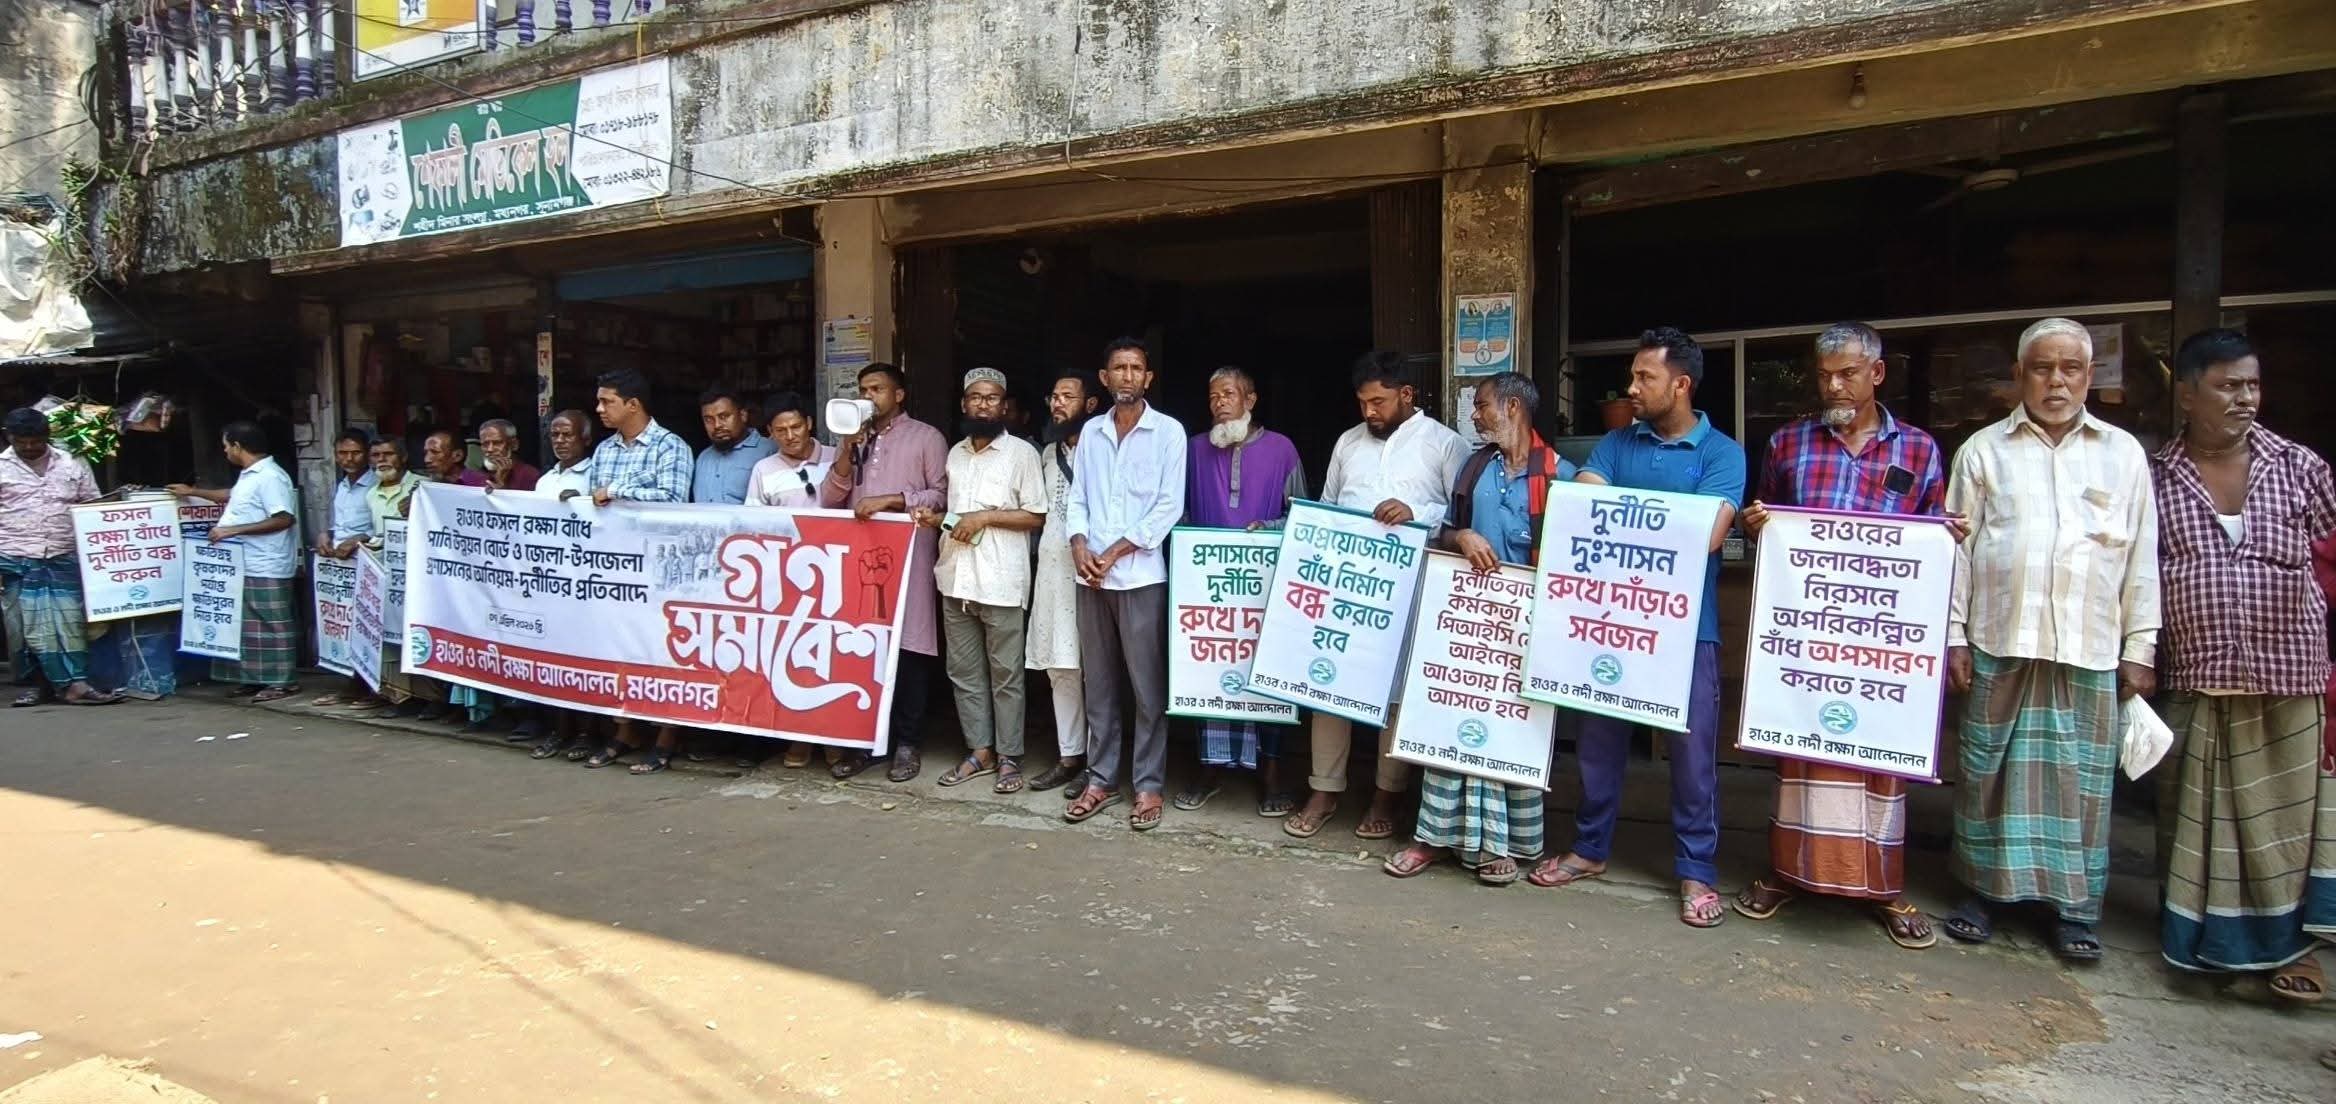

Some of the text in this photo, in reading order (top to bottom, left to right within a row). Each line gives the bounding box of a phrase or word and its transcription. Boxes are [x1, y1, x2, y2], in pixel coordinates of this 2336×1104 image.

[101, 508, 152, 523] ফসল
[486, 511, 520, 532] ফসল
[524, 515, 558, 536] রক্ষা
[561, 512, 592, 539] বাঁধে
[1590, 494, 1670, 535] দুর্নীতি
[1810, 518, 1904, 547] হাওরের
[85, 529, 130, 547] রক্ষা
[133, 523, 172, 540] বাঁধে
[428, 526, 451, 550] পানি
[452, 531, 481, 557] উন্নয়ন
[484, 534, 510, 559] বোর্ড
[513, 547, 522, 561] ও
[525, 542, 644, 573] জেলা-উপজেলা
[1294, 522, 1416, 570] অপ্রয়োজনীয়
[86, 544, 176, 571] দুর্নীতি বন্ধ
[1192, 544, 1281, 567] প্রশাসনের
[1571, 535, 1678, 576] দুঃশাসন
[1789, 547, 1922, 580] জলাবদ্ধতা
[109, 566, 162, 583] করুন
[427, 557, 472, 581] প্রশাসনের
[472, 561, 572, 598] অনিয়ম-দুর্নীতির
[575, 573, 648, 603] প্রতিবাদে
[722, 538, 850, 618] গণ
[1206, 567, 1263, 603] দুর্নীতি
[1297, 553, 1395, 601] বাঁধ নির্মাণ
[1804, 573, 1899, 609] নিরসনে
[1286, 581, 1393, 631] বন্ধ করতে
[1448, 592, 1521, 623] কর্মকর্তা
[1547, 572, 1689, 620] রুখে দাঁড়াও
[213, 612, 232, 625] হবে
[1178, 604, 1237, 633] রুখে
[1436, 610, 1515, 645] পিআইসি
[1568, 611, 1659, 655] সর্বজন
[1772, 605, 1928, 646] অপরিকল্পিত
[669, 594, 894, 711] সমাবেশ
[1189, 636, 1259, 664] জনগ
[1312, 625, 1350, 653] হবে
[1449, 641, 1523, 671] আইনের
[1760, 629, 1936, 677] বাঁধ অপসারণ
[435, 637, 720, 709] হাওর ও নদী রক্ষা আন্দোলন, মধ্যনগর
[1423, 662, 1524, 697] আওতায় নি
[1780, 667, 1907, 704] করতে হবে
[1175, 696, 1197, 707] হাওর
[1199, 697, 1206, 708] ও
[1207, 696, 1224, 710] নদী
[1247, 702, 1293, 716] আন্দোলন
[1254, 673, 1279, 689] হাওর
[1280, 680, 1288, 690] ও
[1290, 681, 1308, 695] নদী
[1333, 694, 1381, 717] আন্দোলন
[1428, 686, 1530, 721] আসতে হবে
[1530, 676, 1680, 719] হাওর ও নদী রক্ষা আন্দোলন
[1399, 738, 1541, 779] হাওর ও নদী রক্ষা আন্দোলন
[1749, 727, 1927, 768] হাওর ও নদী রক্ষা আন্দোলন
